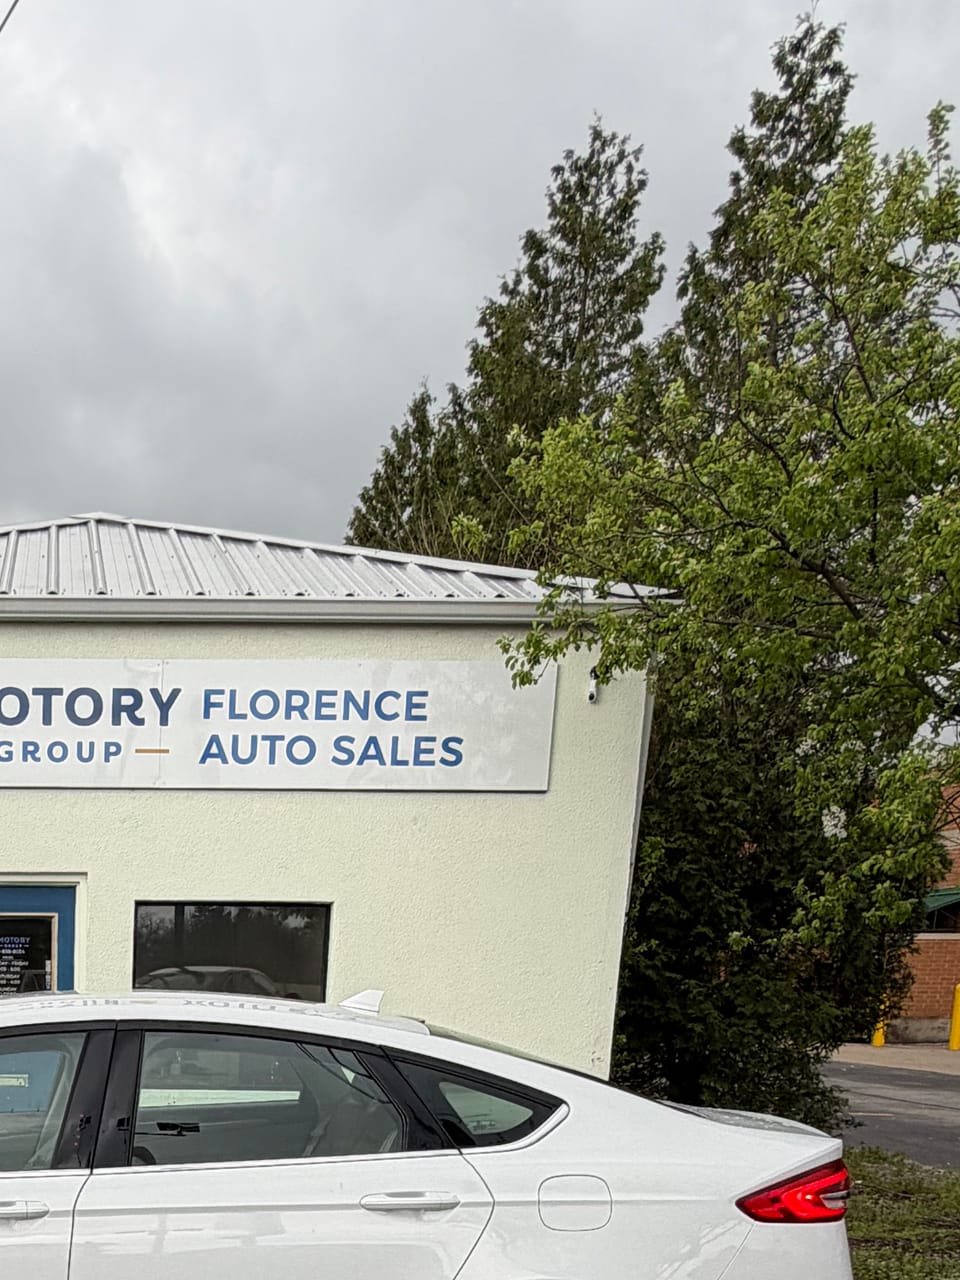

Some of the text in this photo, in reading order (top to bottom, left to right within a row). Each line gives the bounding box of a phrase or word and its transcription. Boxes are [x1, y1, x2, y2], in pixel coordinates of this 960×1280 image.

[202, 688, 429, 721] FLORENCE
[198, 733, 464, 767] AUTO SALES
